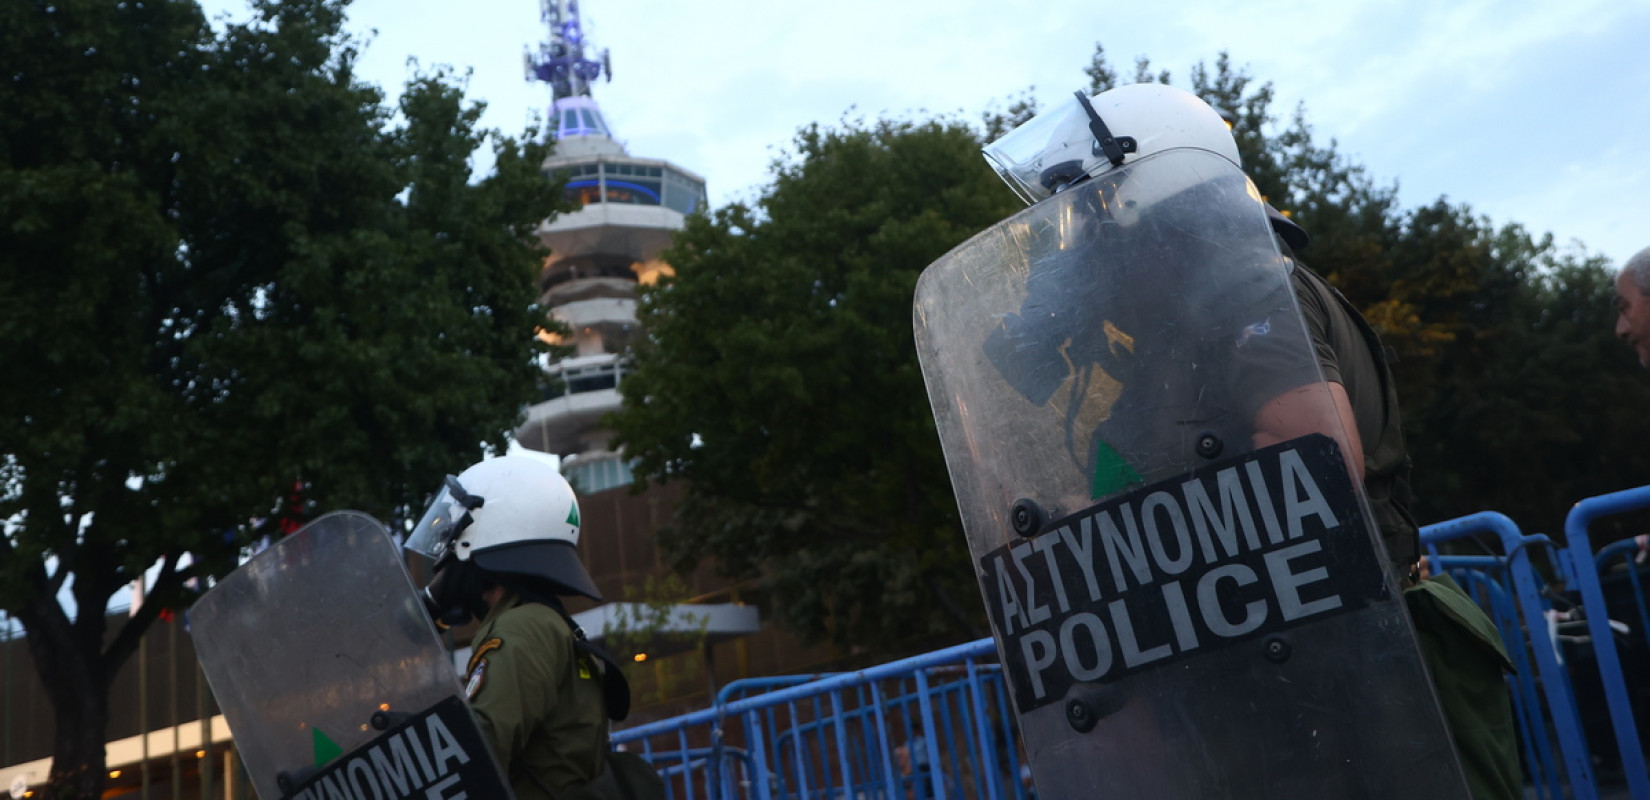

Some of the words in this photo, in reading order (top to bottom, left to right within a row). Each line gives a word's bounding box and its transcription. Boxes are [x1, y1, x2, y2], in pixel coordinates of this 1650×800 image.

[994, 448, 1340, 636] ΑΣΤΥΝΟΜΙΑ
[1020, 539, 1342, 699] POLICE
[292, 712, 470, 800] ΝΟΜΙΑ
